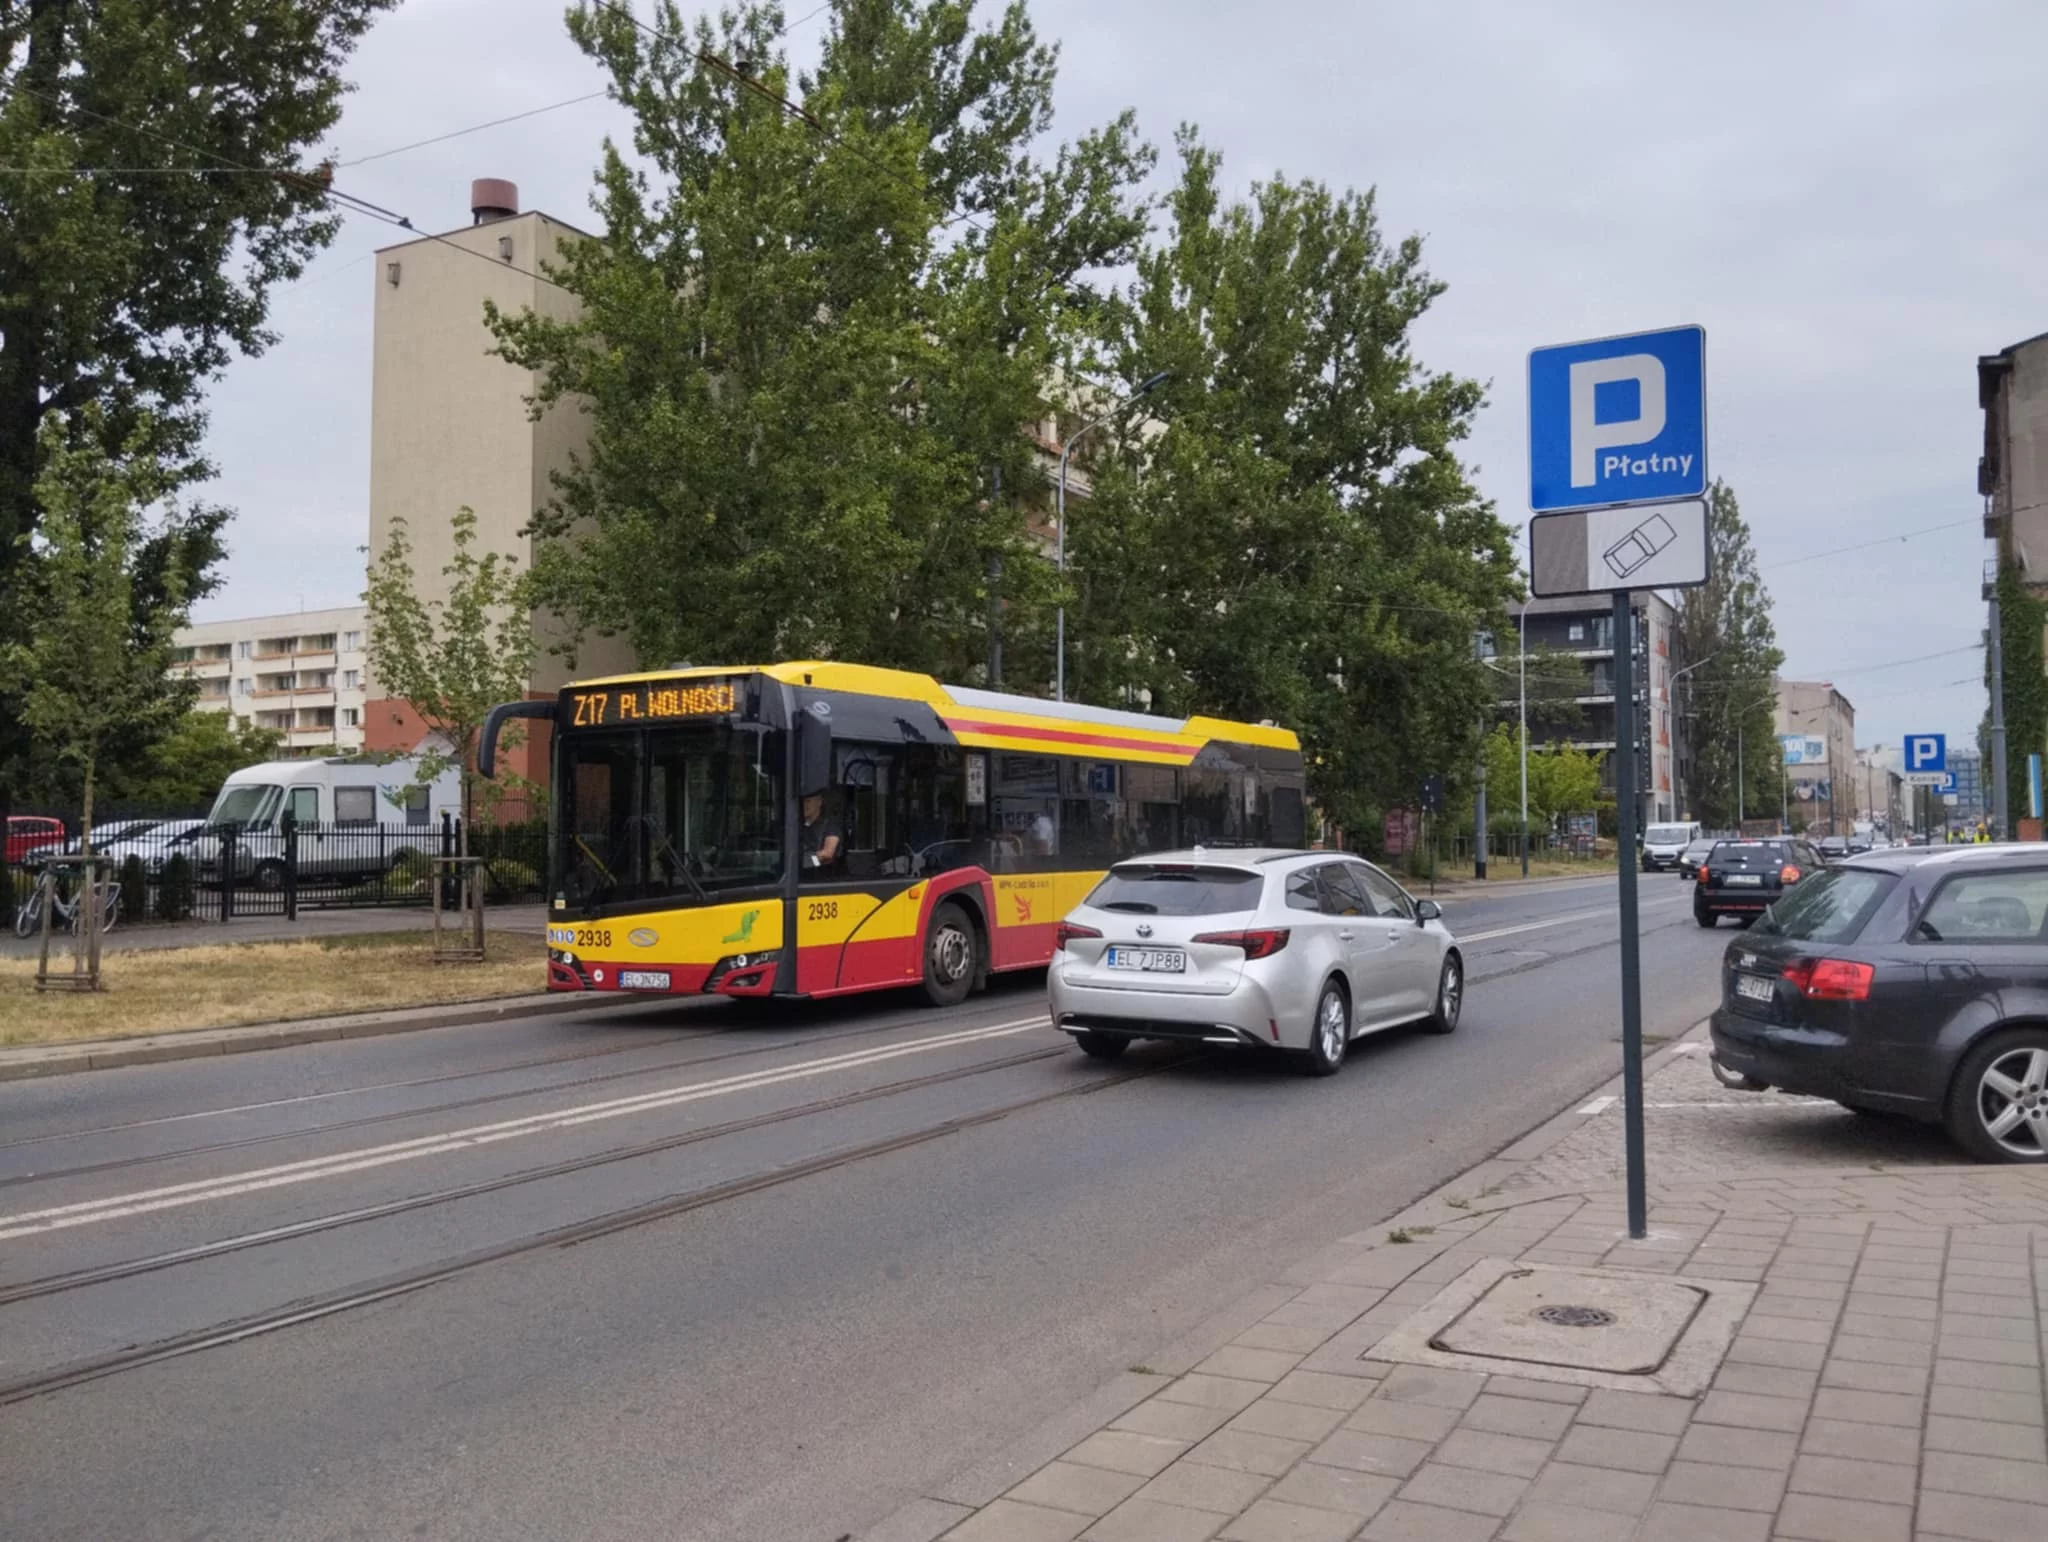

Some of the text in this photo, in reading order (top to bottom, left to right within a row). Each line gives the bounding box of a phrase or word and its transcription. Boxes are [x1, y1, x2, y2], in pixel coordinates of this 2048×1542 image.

[1569, 353, 1666, 488] P
[1604, 453, 1693, 479] Płatny
[573, 684, 735, 727] Z17 PL. WOLNOŚCI
[1913, 738, 1937, 768] P
[808, 902, 838, 920] 2938
[577, 929, 612, 947] 2938
[1117, 951, 1181, 969] EL 7JP88
